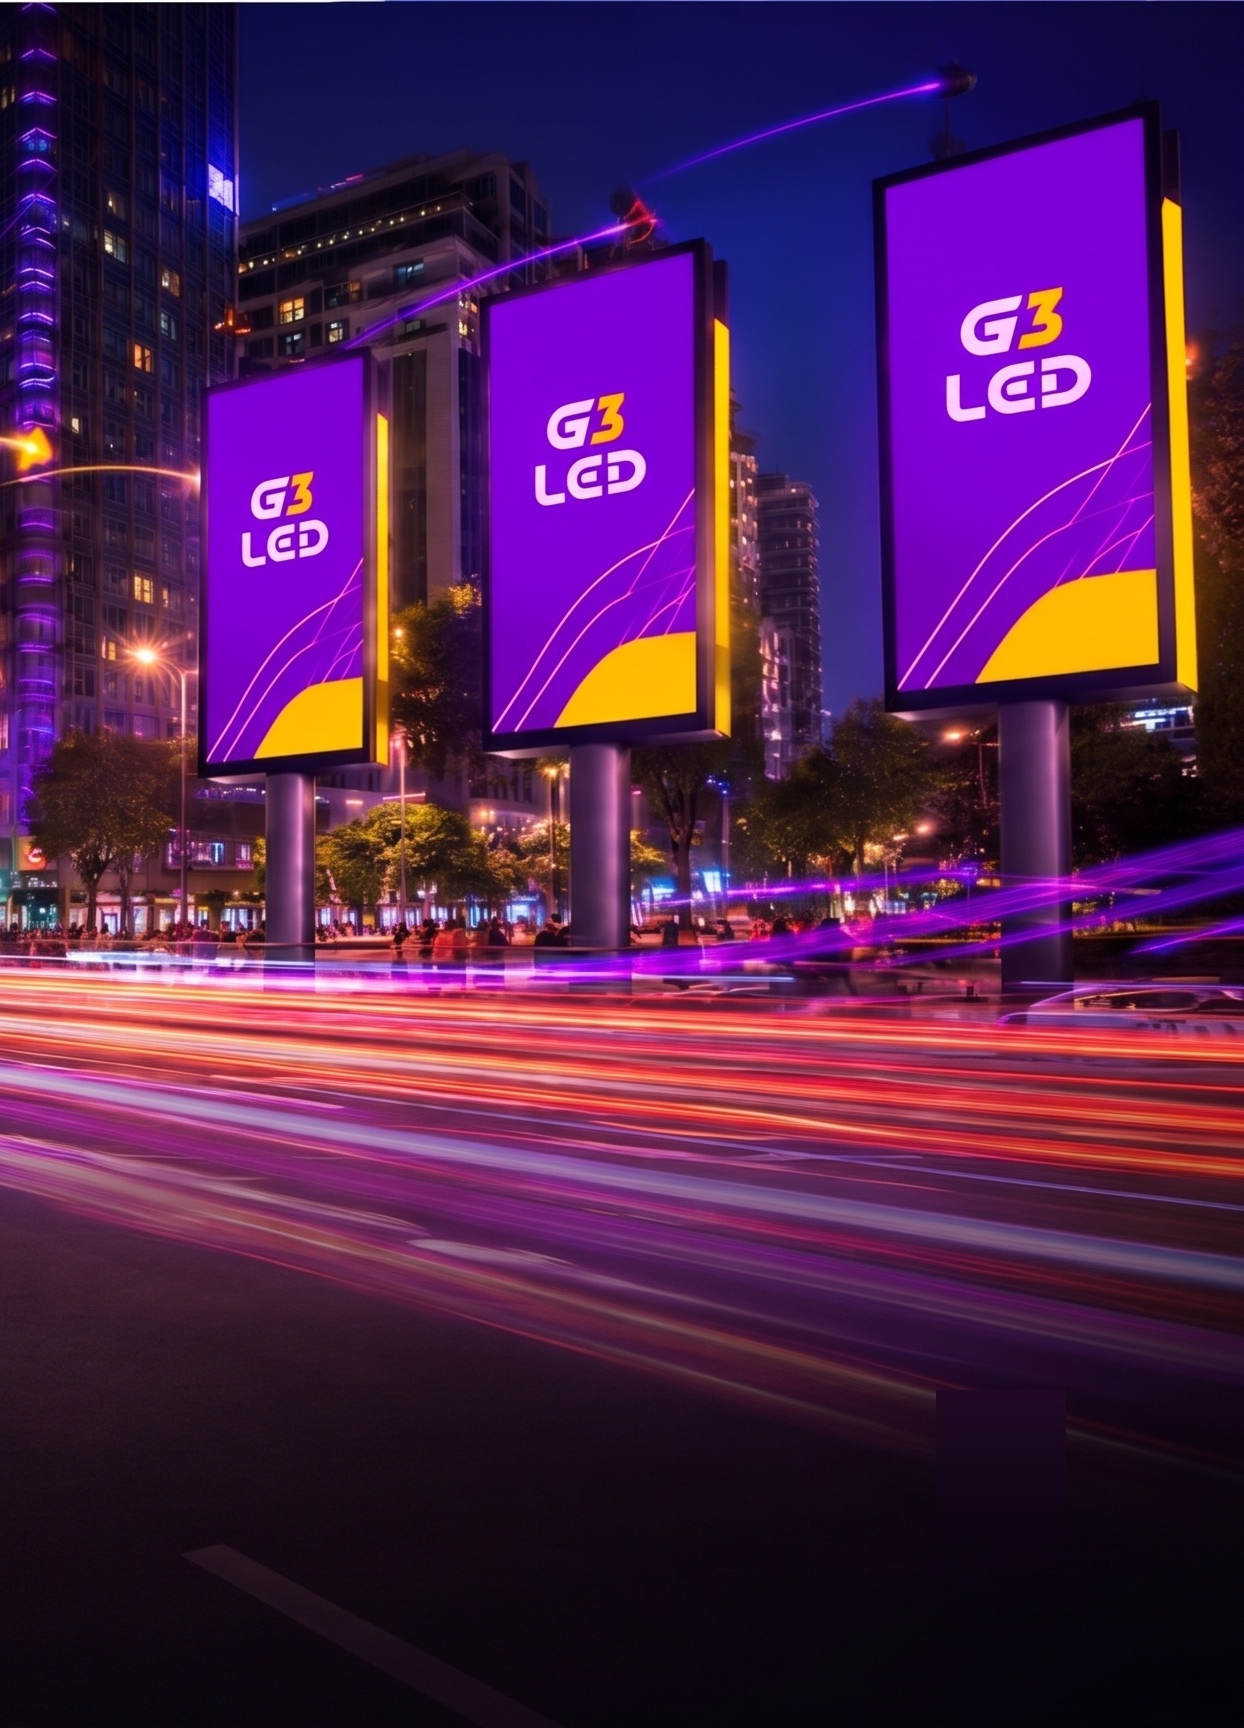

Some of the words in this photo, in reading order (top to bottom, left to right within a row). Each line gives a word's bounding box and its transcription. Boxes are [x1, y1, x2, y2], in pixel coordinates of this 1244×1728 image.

[960, 287, 1063, 356] G3
[946, 354, 1092, 423] LED
[546, 392, 625, 450] G3
[250, 471, 314, 520] G3
[534, 449, 647, 507] LED
[241, 519, 329, 568] LED
